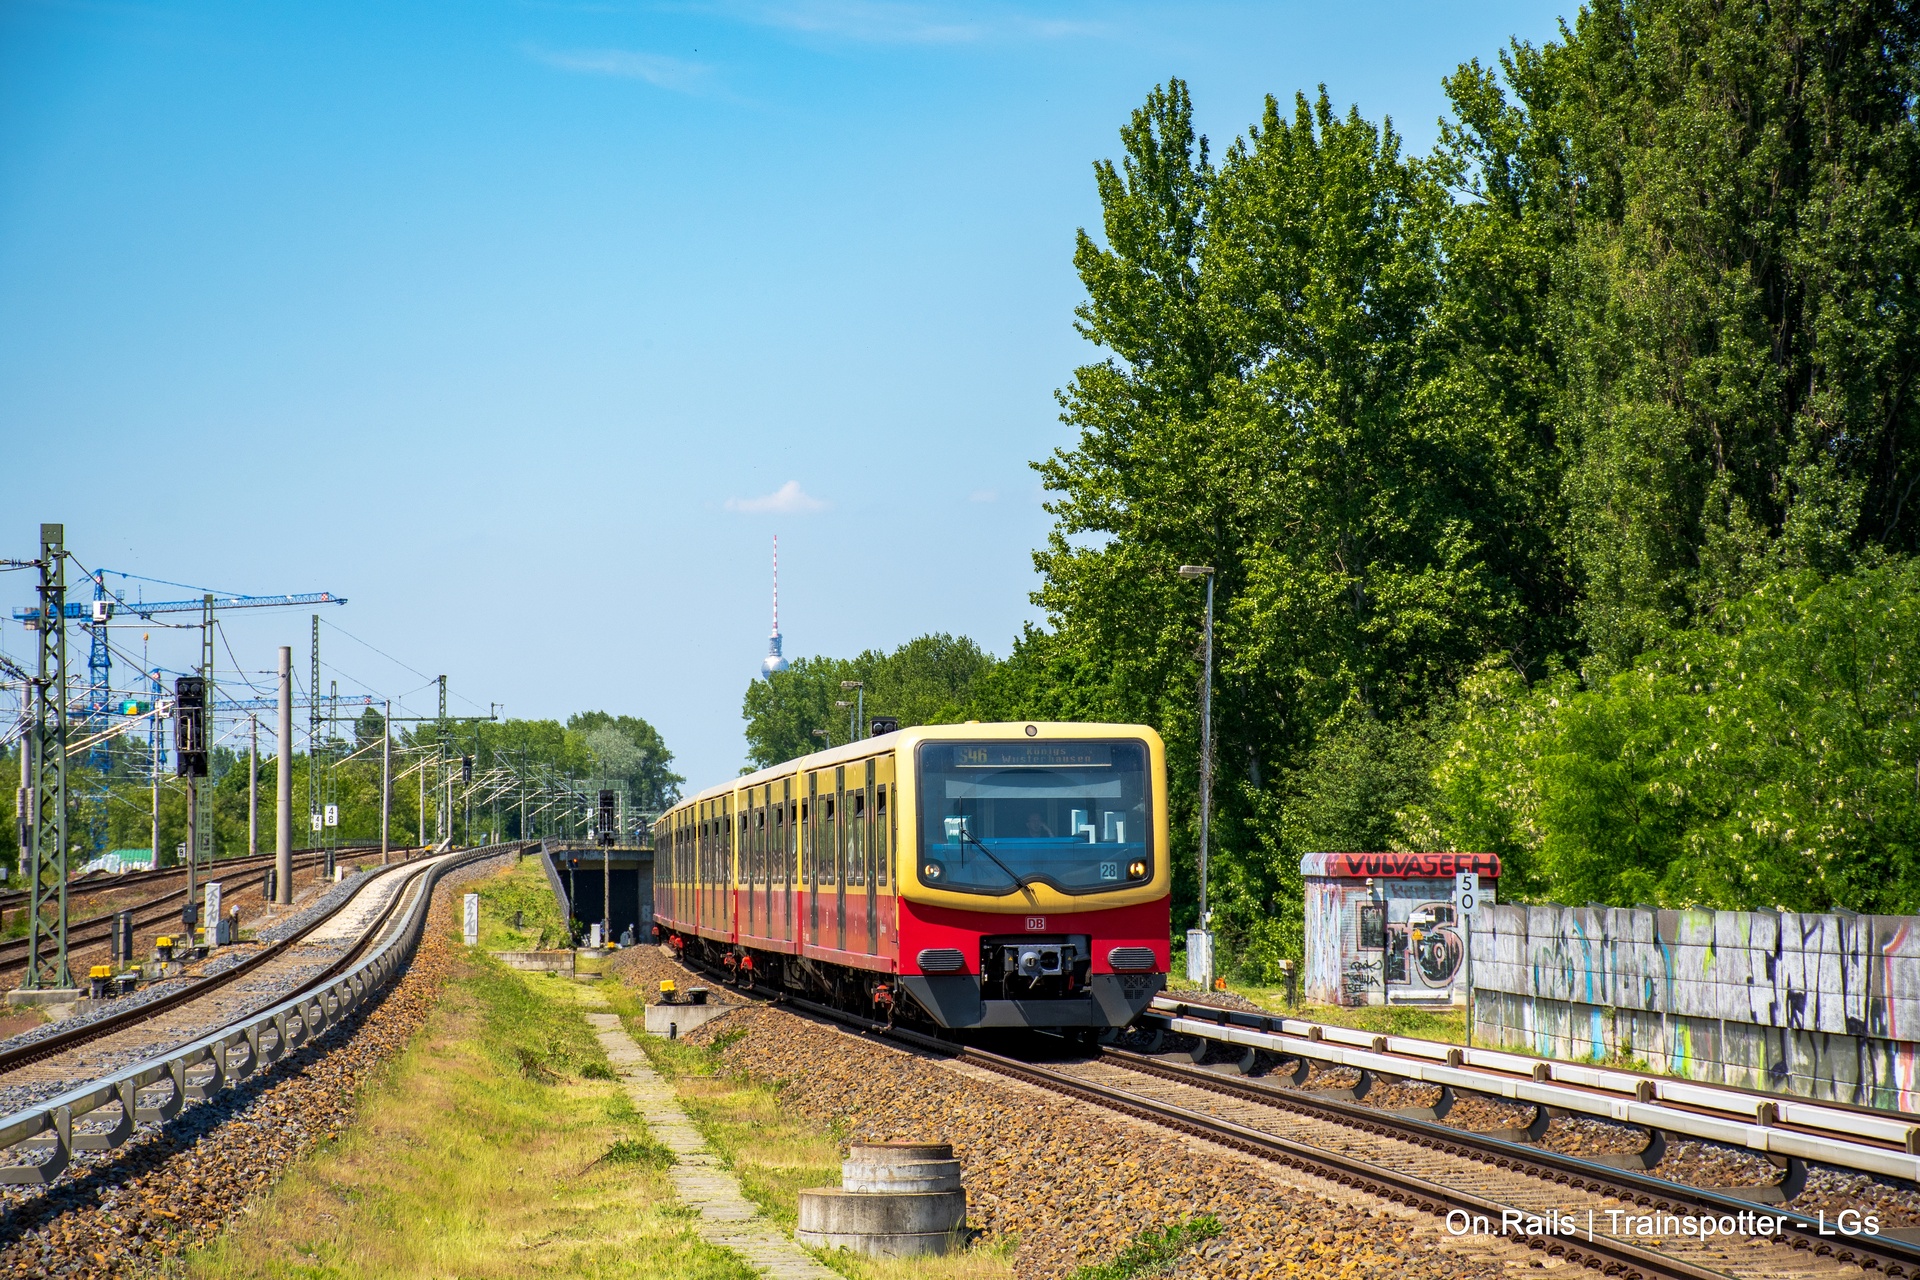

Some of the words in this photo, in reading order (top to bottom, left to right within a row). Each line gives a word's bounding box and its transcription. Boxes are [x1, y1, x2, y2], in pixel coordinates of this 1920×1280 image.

[960, 747, 988, 763] S46
[1102, 864, 1116, 877] 28
[1027, 918, 1045, 930] DB
